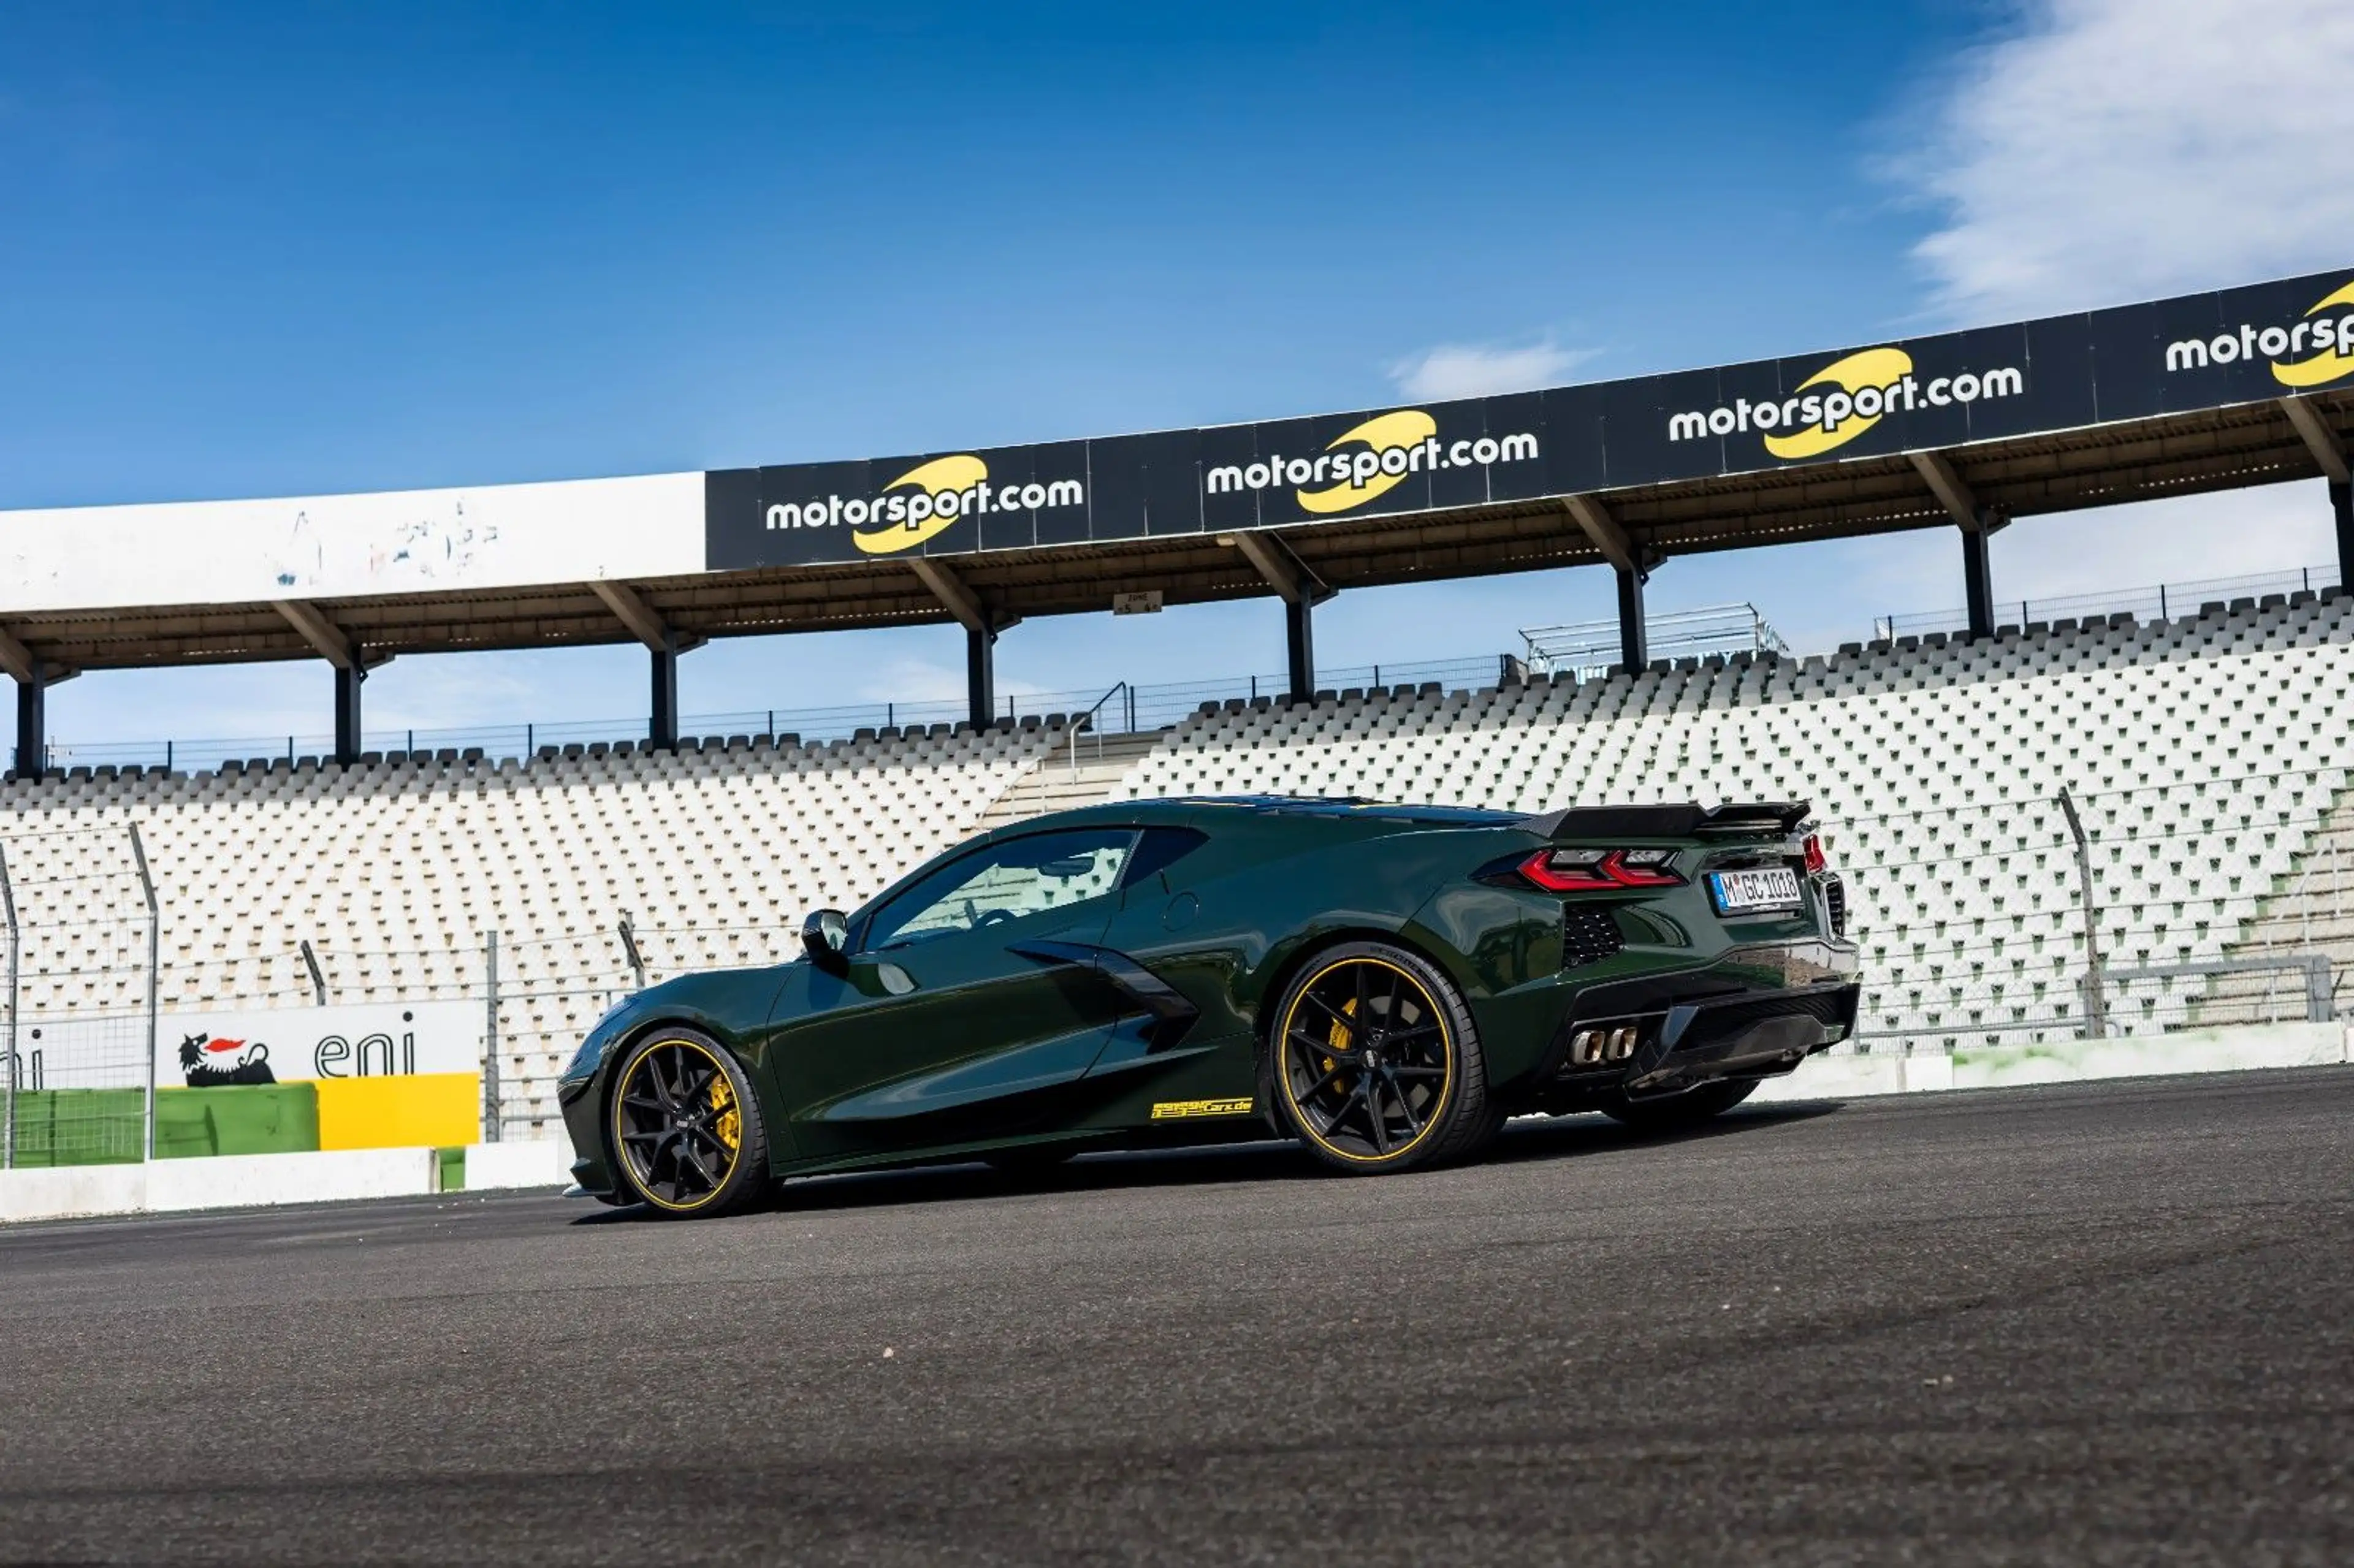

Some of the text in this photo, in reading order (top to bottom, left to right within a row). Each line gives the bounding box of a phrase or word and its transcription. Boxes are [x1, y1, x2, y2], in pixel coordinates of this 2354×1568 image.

[1669, 367, 2022, 441] motorsport.com
[1208, 433, 1538, 493] motorsport.com
[766, 479, 1083, 530] motorsport.com
[1721, 872, 1797, 903] M GC 1018
[314, 1011, 414, 1079] eni
